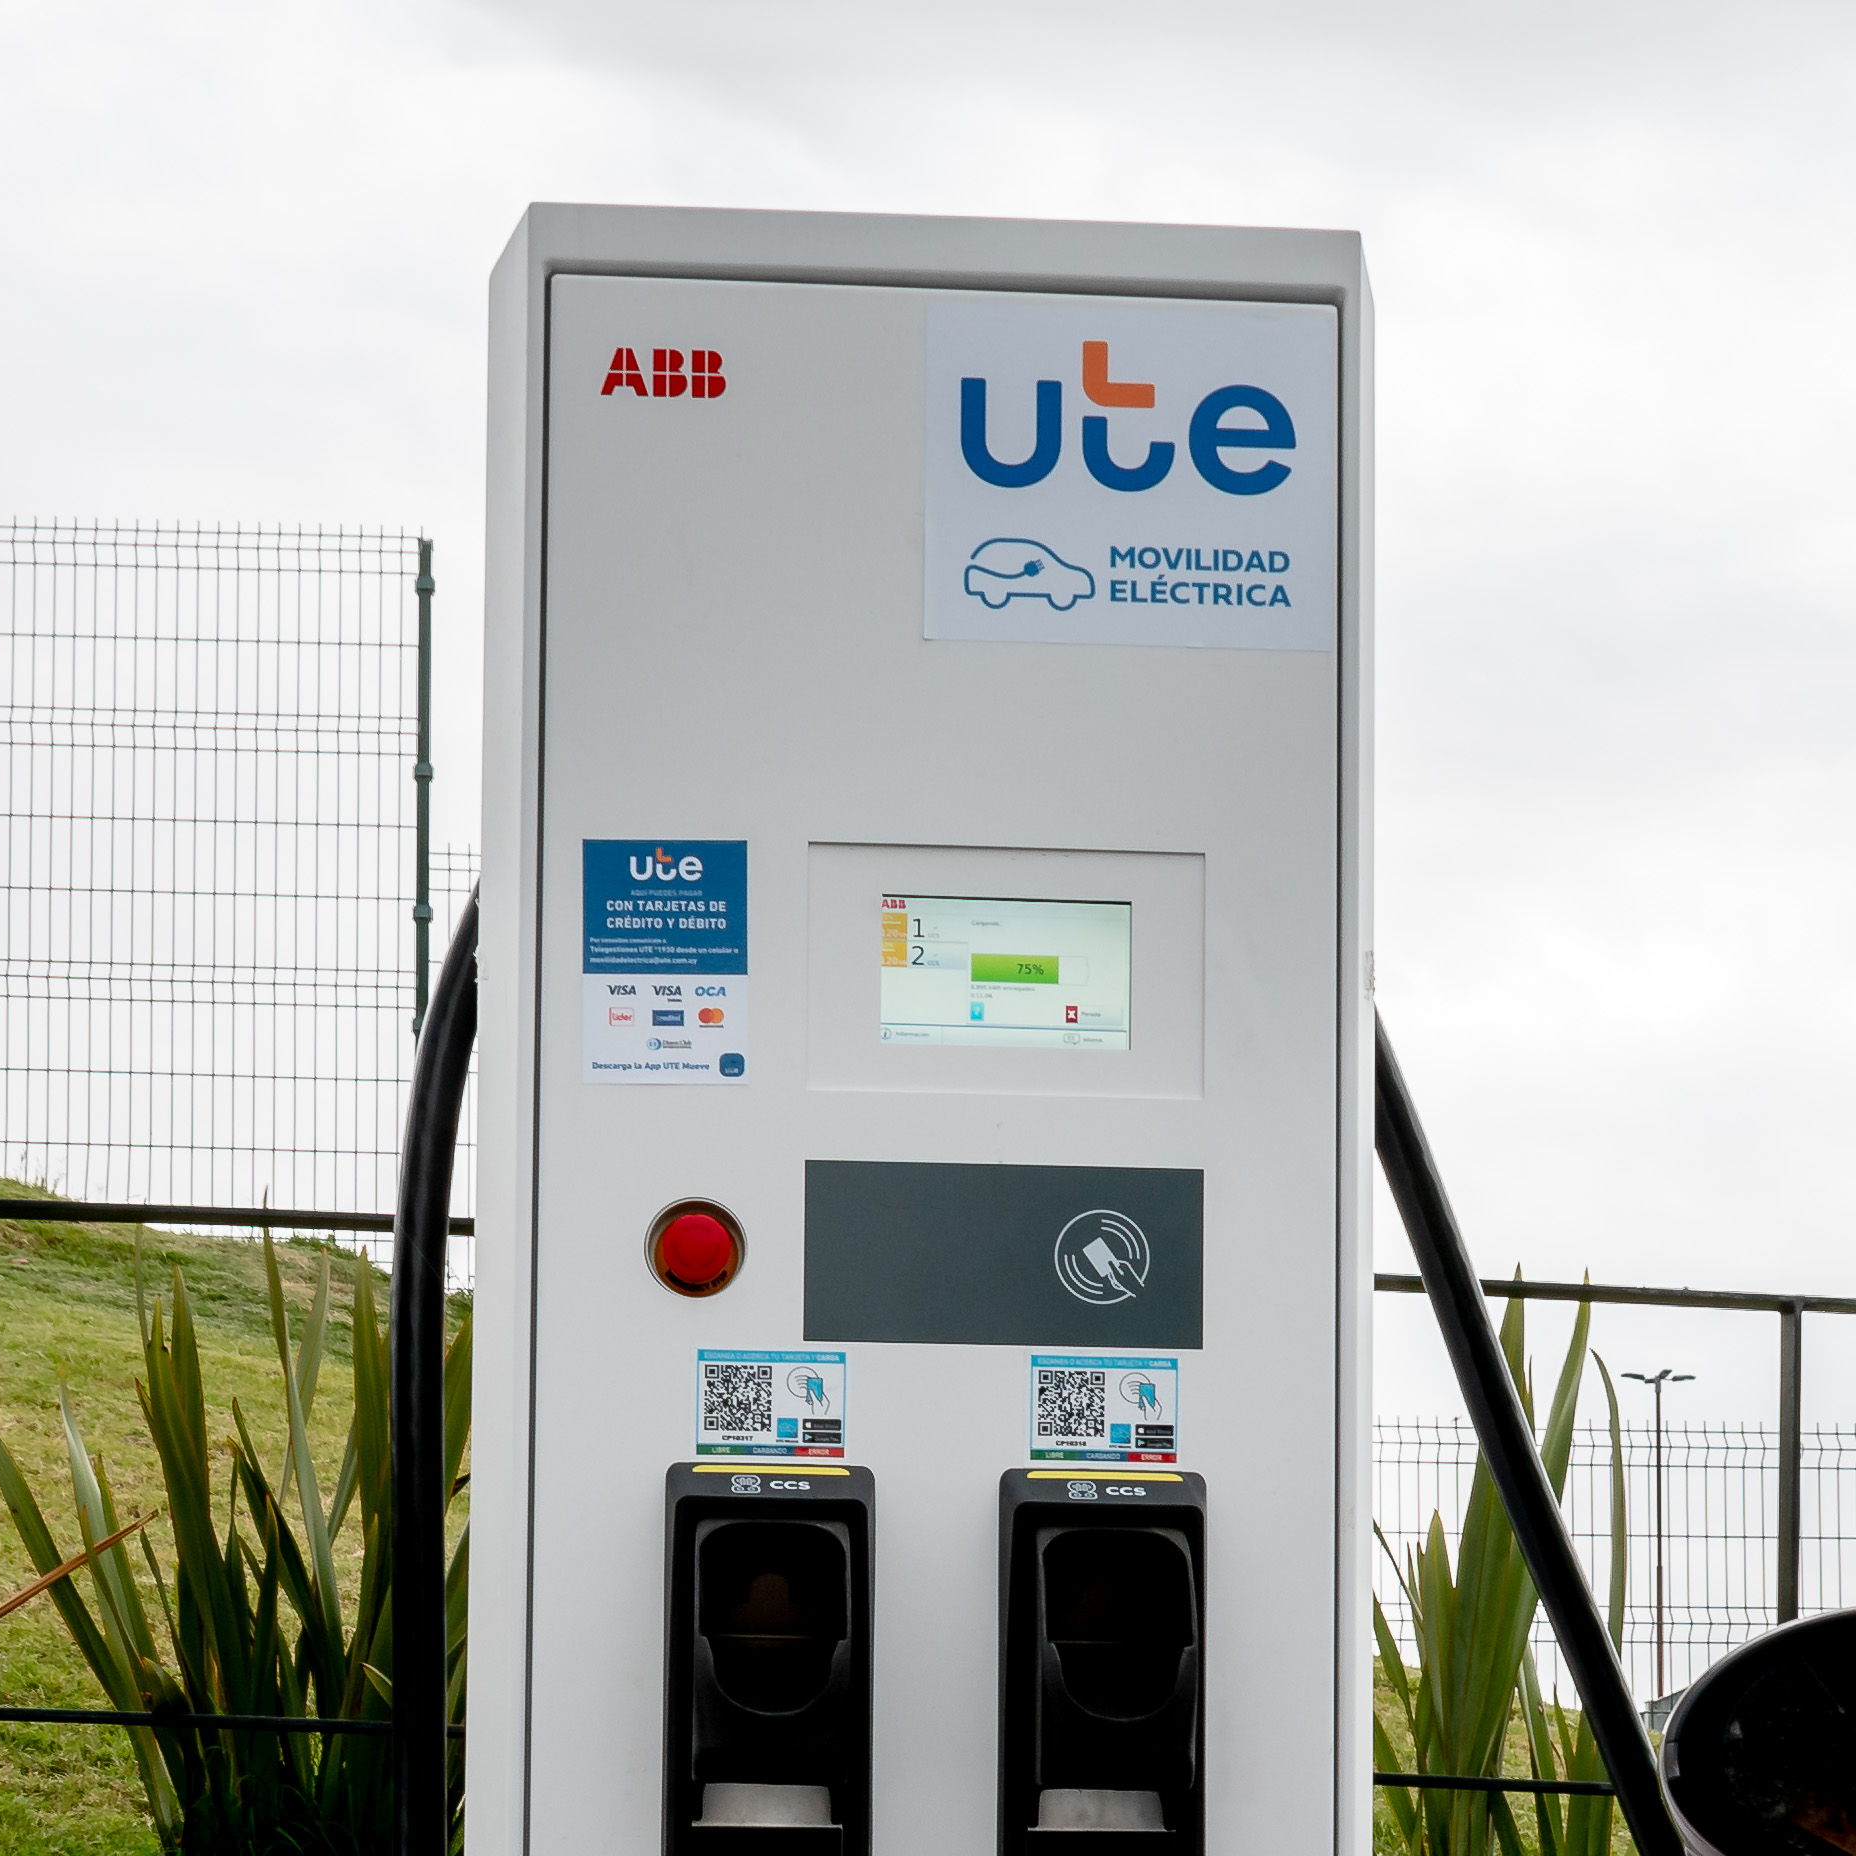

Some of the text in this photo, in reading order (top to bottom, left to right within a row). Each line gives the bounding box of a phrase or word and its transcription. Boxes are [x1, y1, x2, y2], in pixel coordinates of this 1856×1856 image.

[600, 346, 727, 399] ABB
[960, 340, 1297, 496] ute
[1109, 545, 1291, 574] MOVILIDAD
[1109, 573, 1292, 608] ELÉCTRICA
[629, 847, 704, 882] ute
[606, 900, 727, 912] CON TARJETAS DE
[882, 899, 906, 909] ABB
[606, 915, 727, 930] CRÉDITO Y DÉBITO
[913, 918, 925, 938] 1
[911, 945, 925, 966] 2
[1016, 963, 1045, 976] 75%
[606, 984, 637, 996] VISA
[651, 984, 683, 996] VISA
[695, 986, 727, 997] OCA
[591, 1062, 632, 1071] Descarga
[634, 1062, 642, 1070] la
[644, 1062, 662, 1071] App
[663, 1062, 680, 1070] UTE
[808, 1448, 830, 1456] ERROR
[769, 1480, 811, 1491] CCS
[1104, 1486, 1147, 1497] CCS
